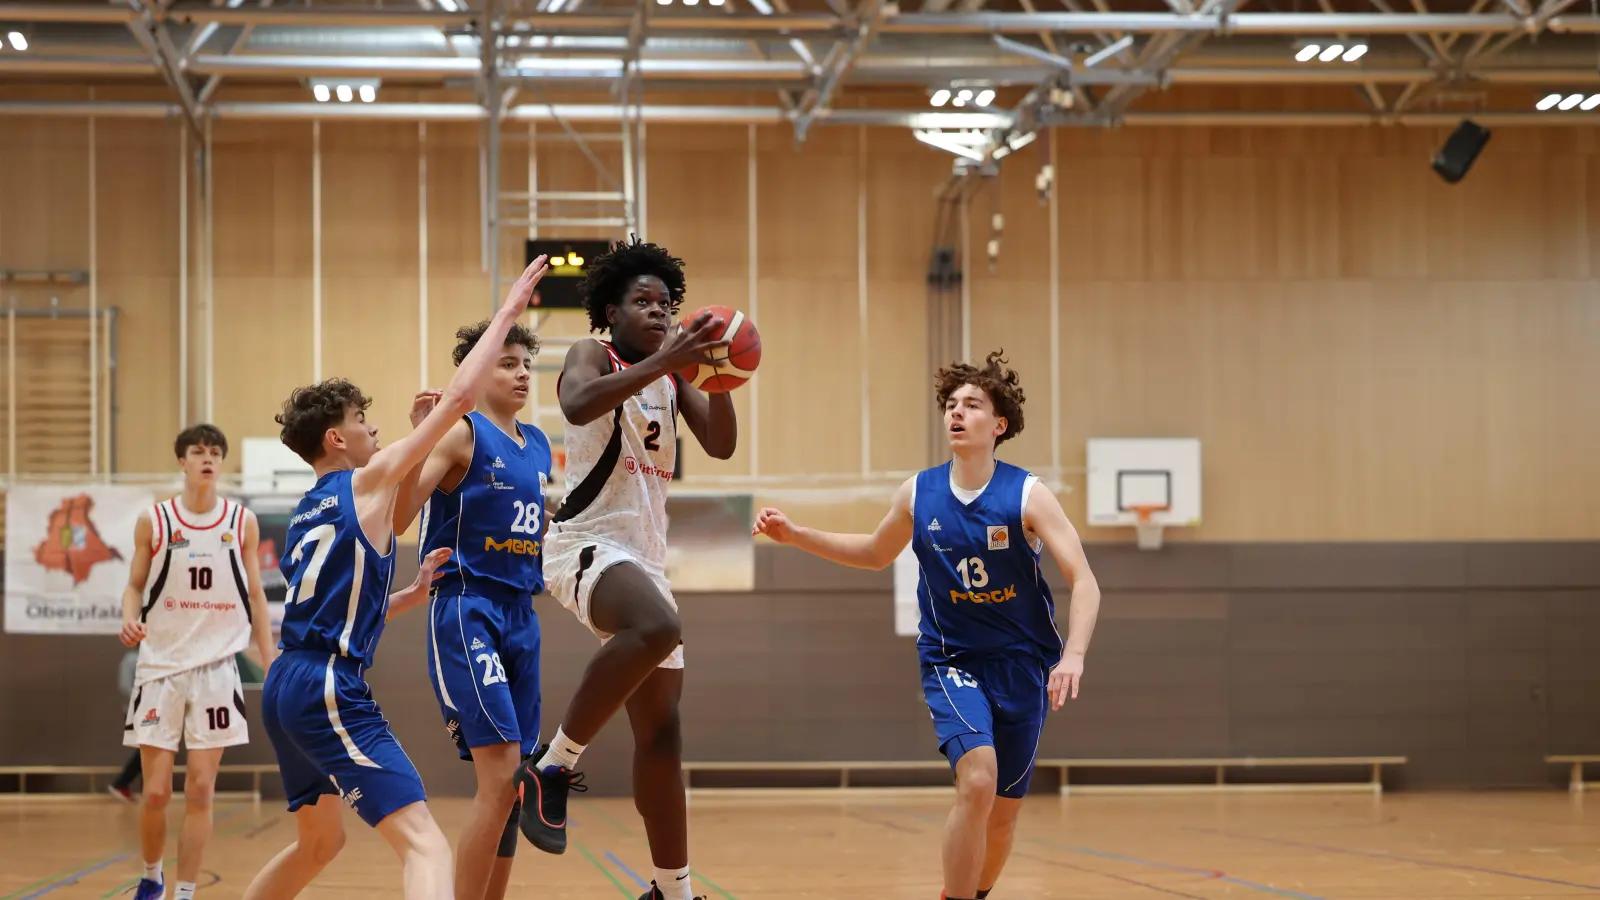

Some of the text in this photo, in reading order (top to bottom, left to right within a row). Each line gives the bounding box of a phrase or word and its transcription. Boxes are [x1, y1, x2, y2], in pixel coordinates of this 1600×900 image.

[644, 420, 661, 451] 2
[510, 500, 541, 535] 28
[188, 566, 213, 591] 10
[956, 556, 989, 590] 13
[180, 601, 237, 611] Witt-Gruppe
[475, 652, 508, 687] 28
[206, 706, 230, 730] 10
